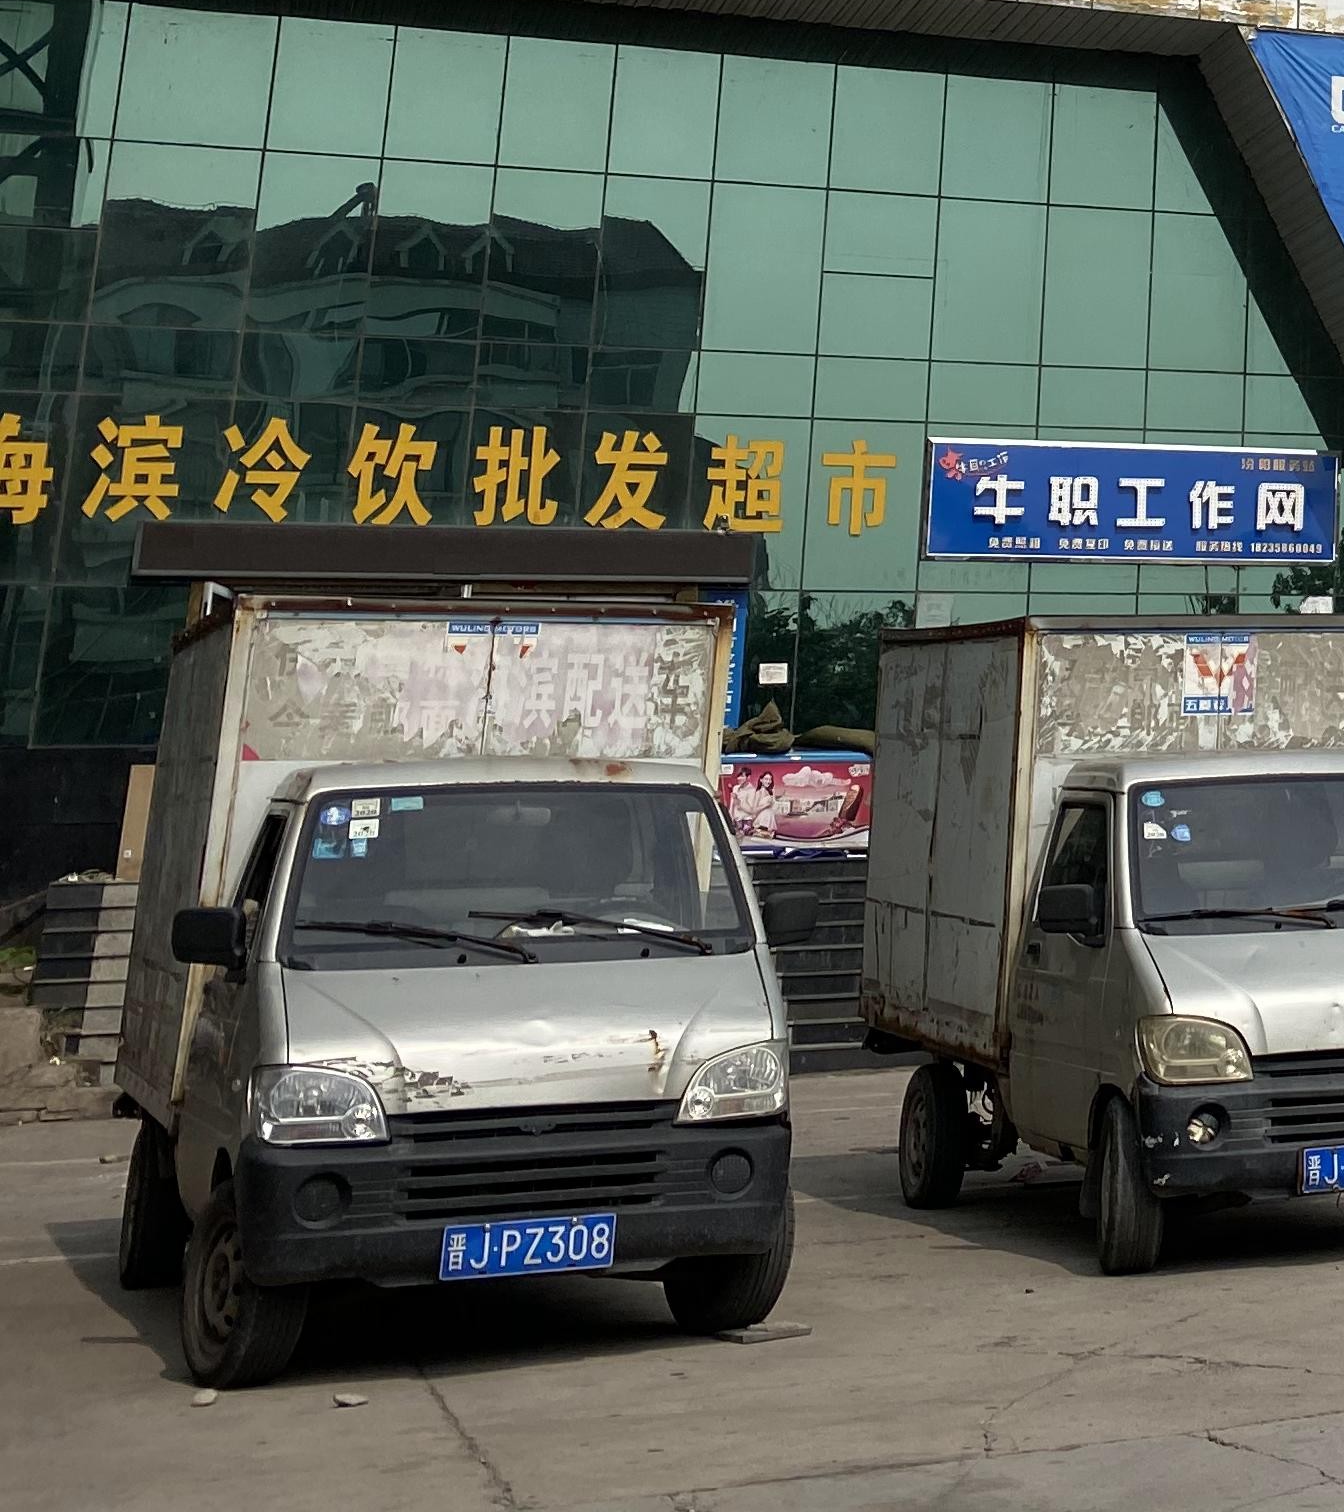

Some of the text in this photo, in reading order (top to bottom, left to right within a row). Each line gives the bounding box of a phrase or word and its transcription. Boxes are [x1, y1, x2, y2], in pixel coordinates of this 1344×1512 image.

[0, 412, 899, 537] 海滨冷饮批发超市
[973, 474, 1304, 532] 牛职工作网
